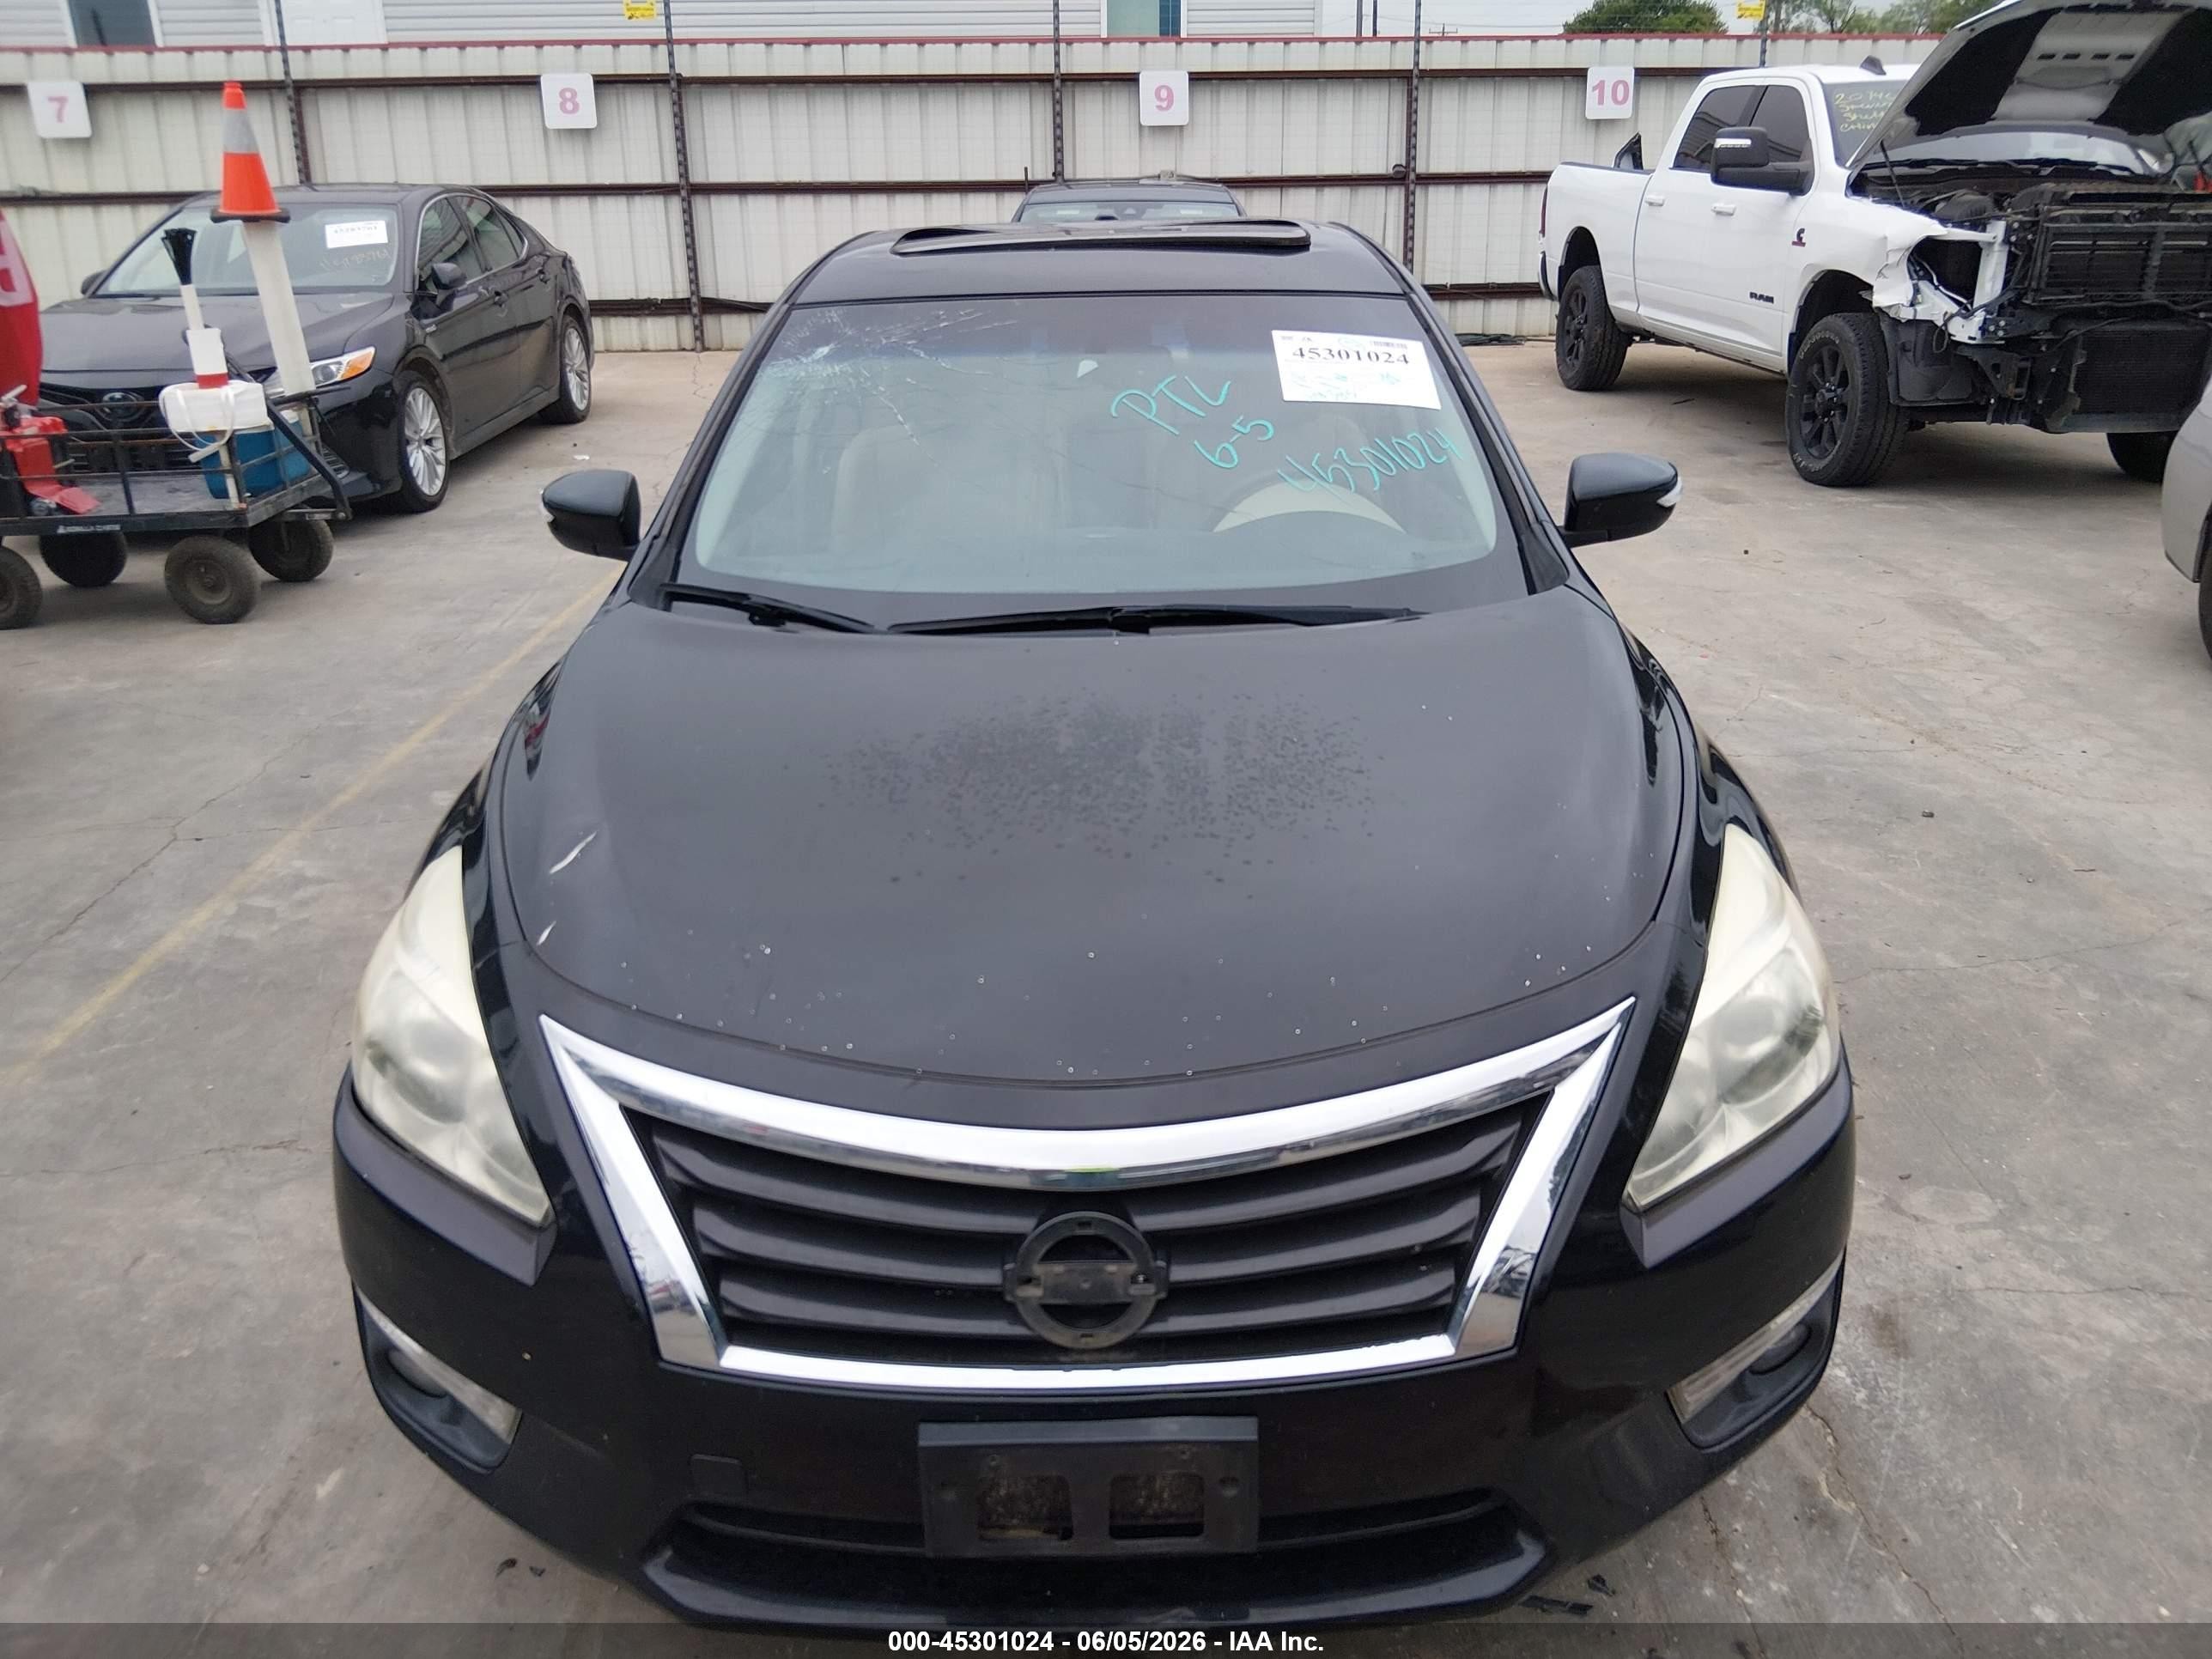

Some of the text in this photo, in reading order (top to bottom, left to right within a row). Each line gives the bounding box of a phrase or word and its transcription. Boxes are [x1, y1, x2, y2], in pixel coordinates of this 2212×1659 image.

[558, 87, 580, 115] 8
[1154, 84, 1174, 112] 9
[1592, 79, 1630, 106] 10
[47, 95, 69, 124] 7
[1292, 346, 1410, 364] 45301024
[1194, 415, 1275, 469] 6-5
[1277, 428, 1462, 495] 45301024
